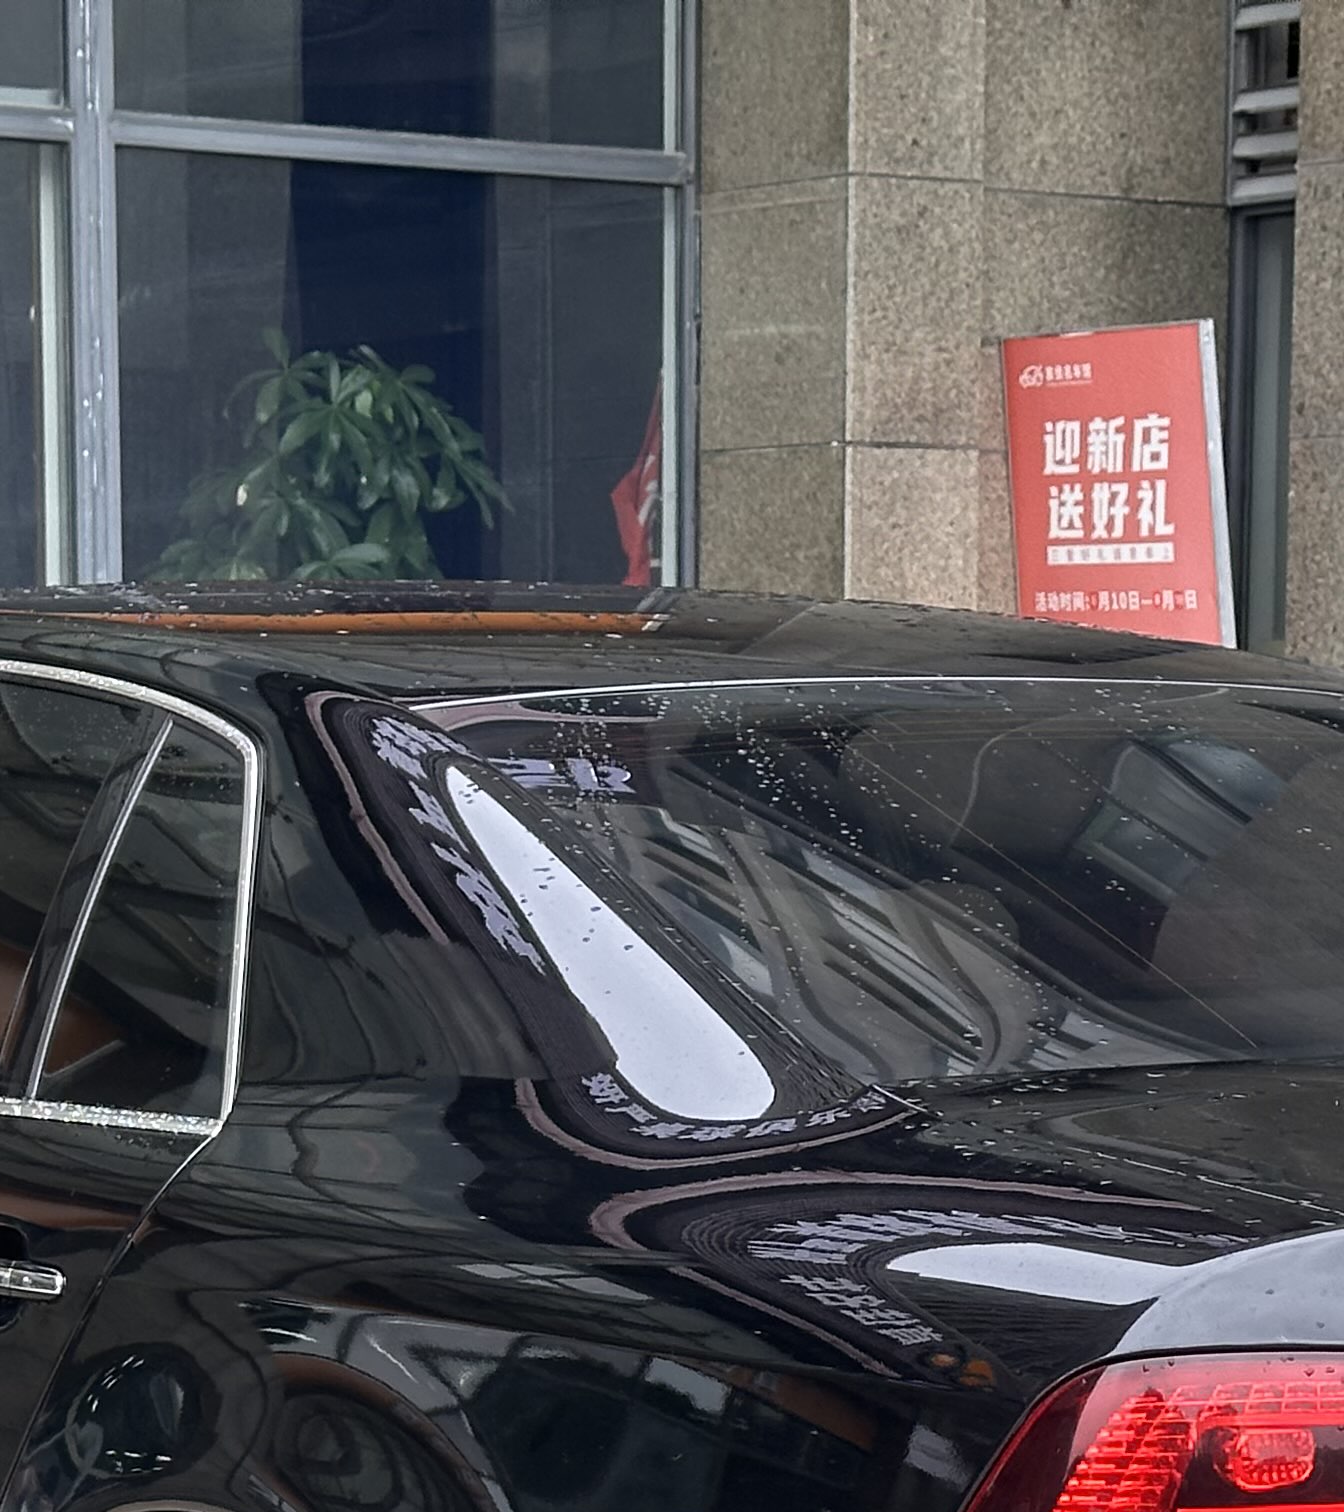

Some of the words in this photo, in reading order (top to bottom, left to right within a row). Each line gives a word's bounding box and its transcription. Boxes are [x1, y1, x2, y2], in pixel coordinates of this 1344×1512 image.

[1043, 413, 1171, 475] 迎新店
[1048, 479, 1175, 540] 送好礼
